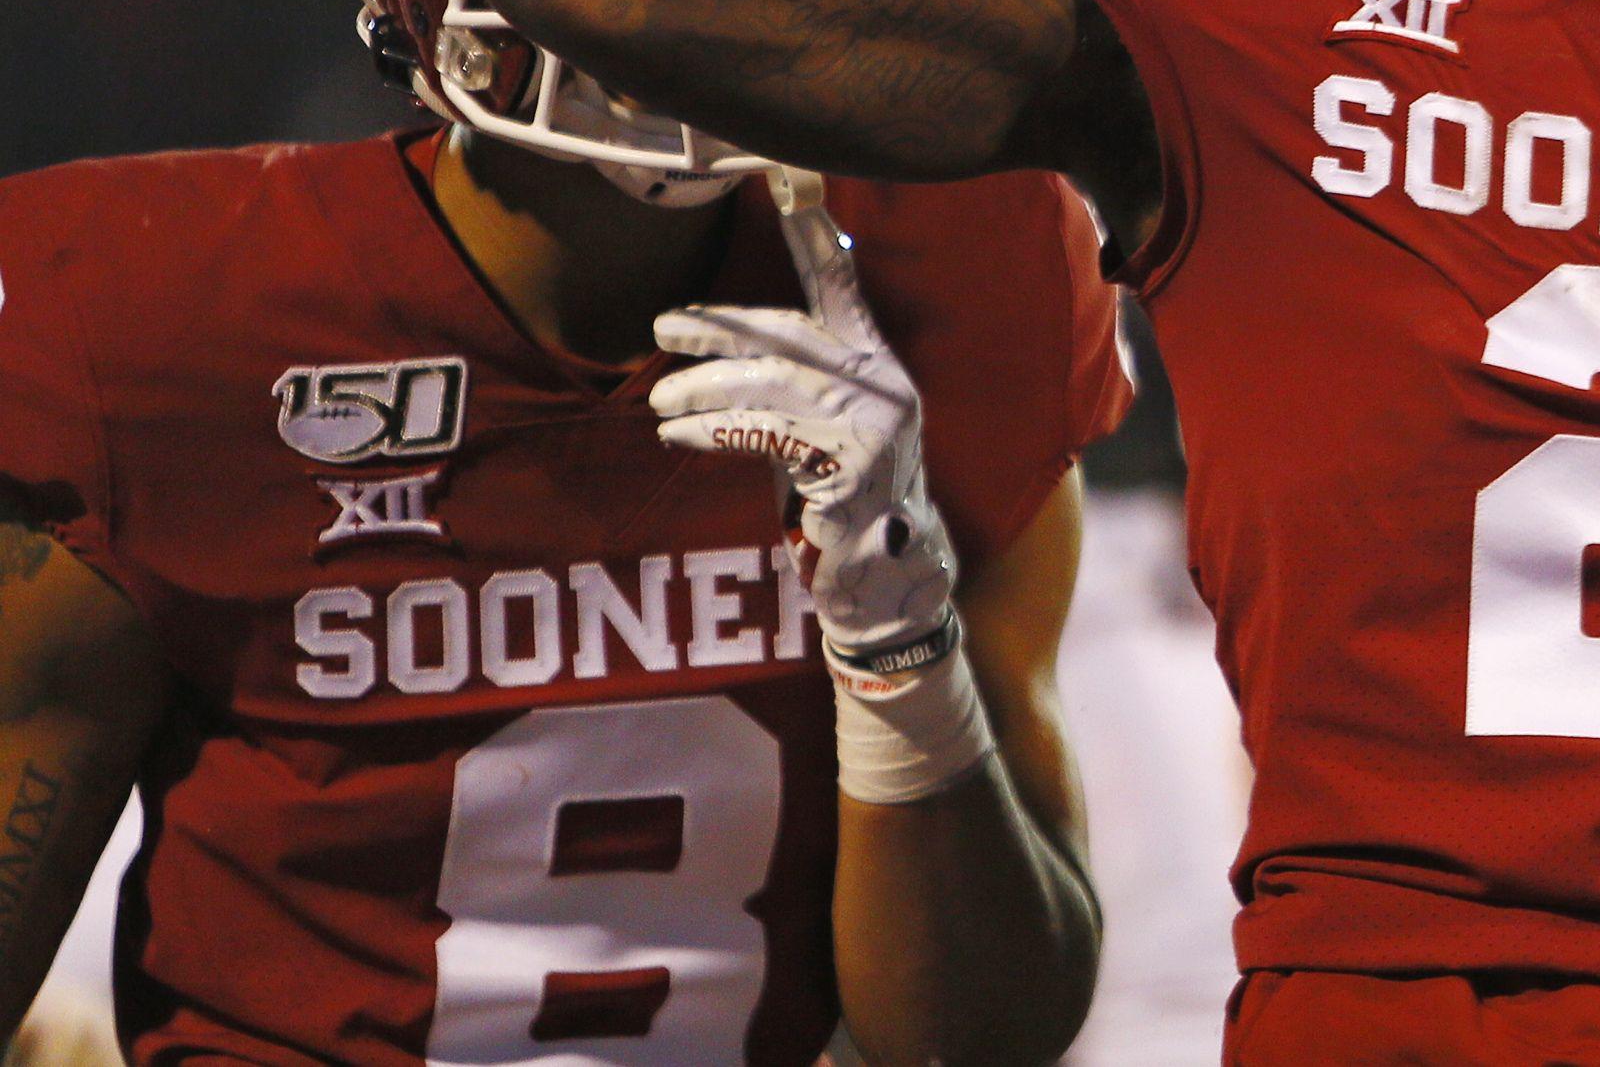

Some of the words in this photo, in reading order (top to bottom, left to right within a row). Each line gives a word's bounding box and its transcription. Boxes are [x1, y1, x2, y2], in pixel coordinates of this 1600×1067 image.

[272, 355, 468, 462] 150
[316, 470, 445, 543] XII
[425, 694, 784, 1067] 8
